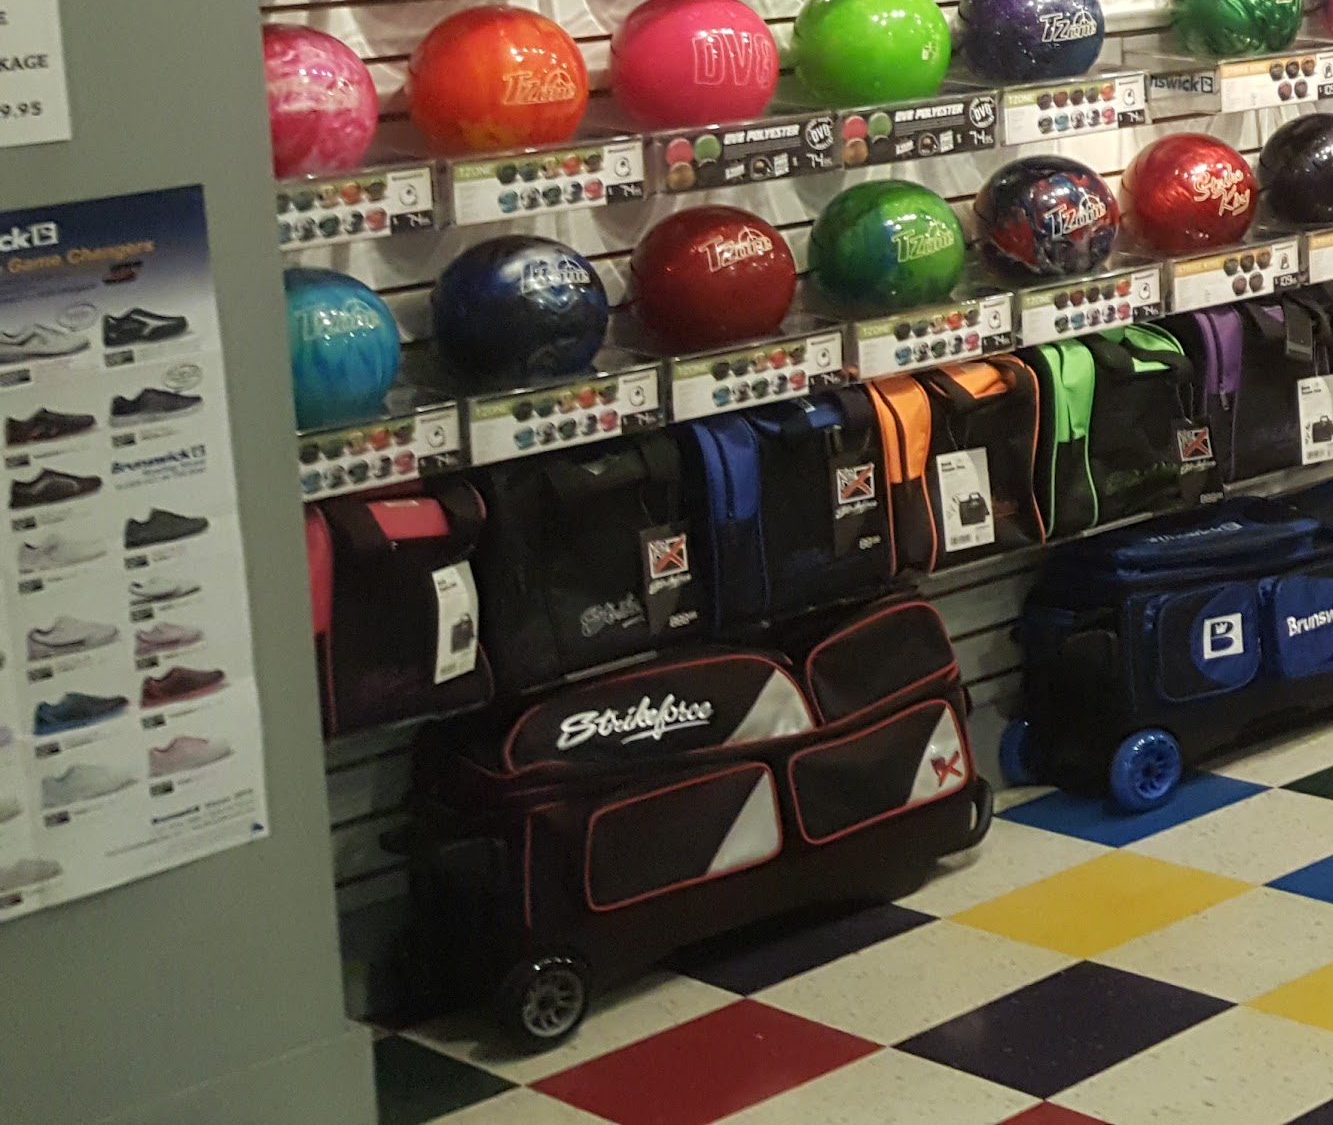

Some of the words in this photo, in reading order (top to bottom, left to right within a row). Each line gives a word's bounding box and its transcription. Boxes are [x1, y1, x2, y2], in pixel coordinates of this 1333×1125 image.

[0, 54, 50, 72] KAGE
[1149, 75, 1199, 92] nswick
[0, 101, 43, 118] 9.95
[916, 103, 964, 120] POLYESTER
[746, 125, 800, 143] POLYESTER
[1209, 620, 1237, 651] B
[557, 694, 713, 750] Strikeforce
